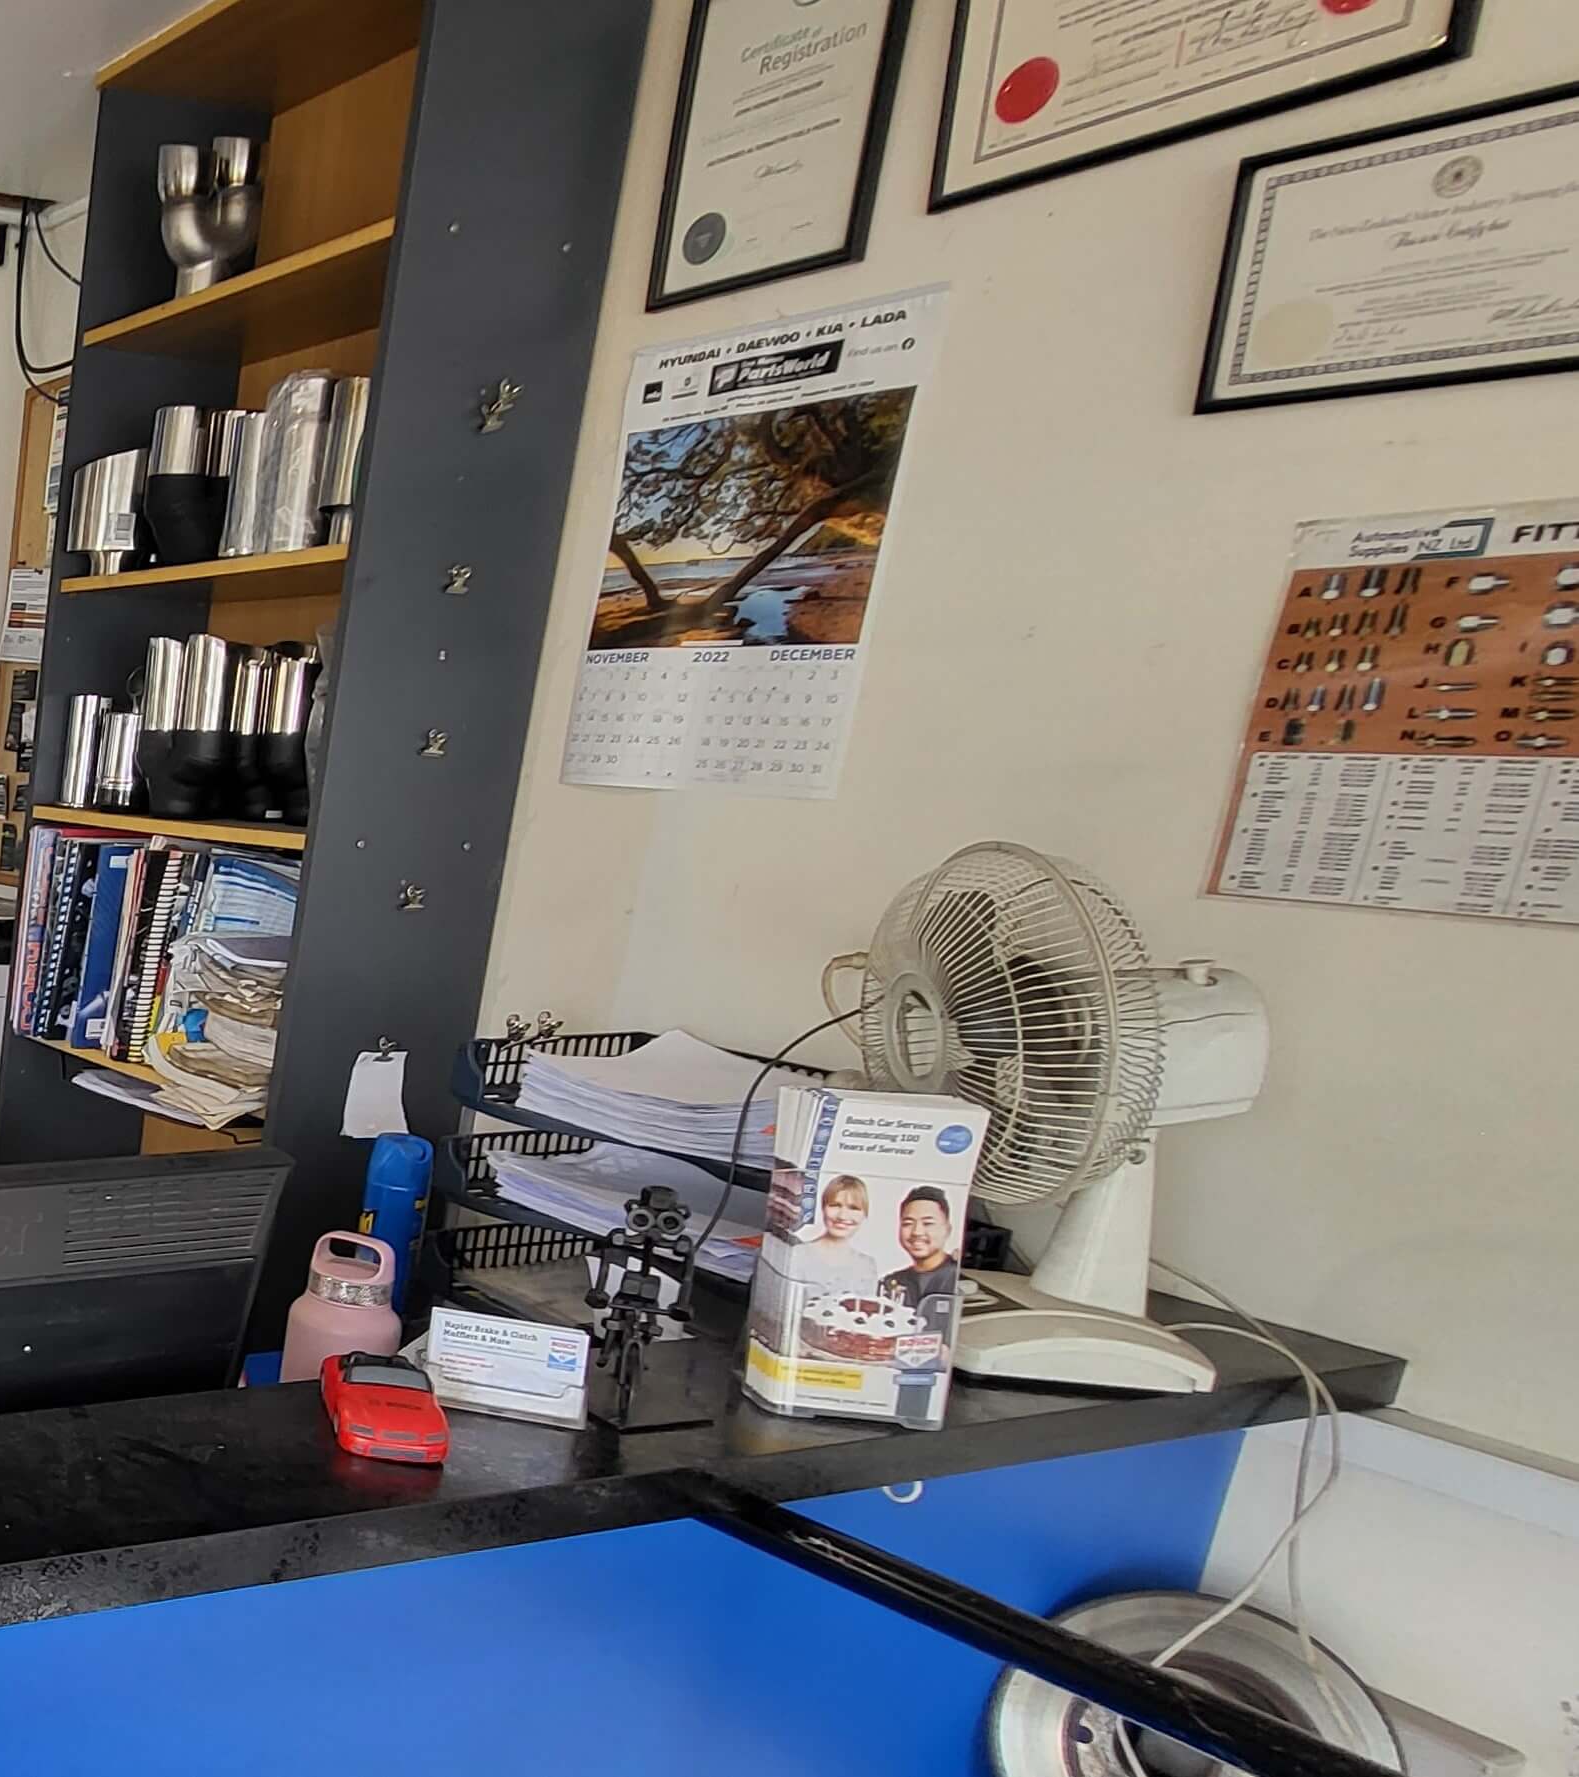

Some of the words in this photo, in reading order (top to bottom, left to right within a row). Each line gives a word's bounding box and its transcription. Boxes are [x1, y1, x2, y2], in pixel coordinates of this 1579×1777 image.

[759, 22, 868, 75] Registration
[659, 348, 721, 369] HYUNDAI
[736, 331, 800, 353] DAEWOO
[815, 323, 843, 337] KIA
[861, 310, 907, 328] LADA
[1354, 528, 1441, 543] Automotive
[1349, 542, 1409, 558] Supplies
[1417, 538, 1444, 552] NZ
[1450, 535, 1475, 551] Ltd
[1297, 587, 1313, 598] A
[586, 652, 649, 664] NOVEMBER
[692, 651, 730, 662] 2022
[770, 649, 856, 661] DECEMBER
[1276, 658, 1290, 670] C
